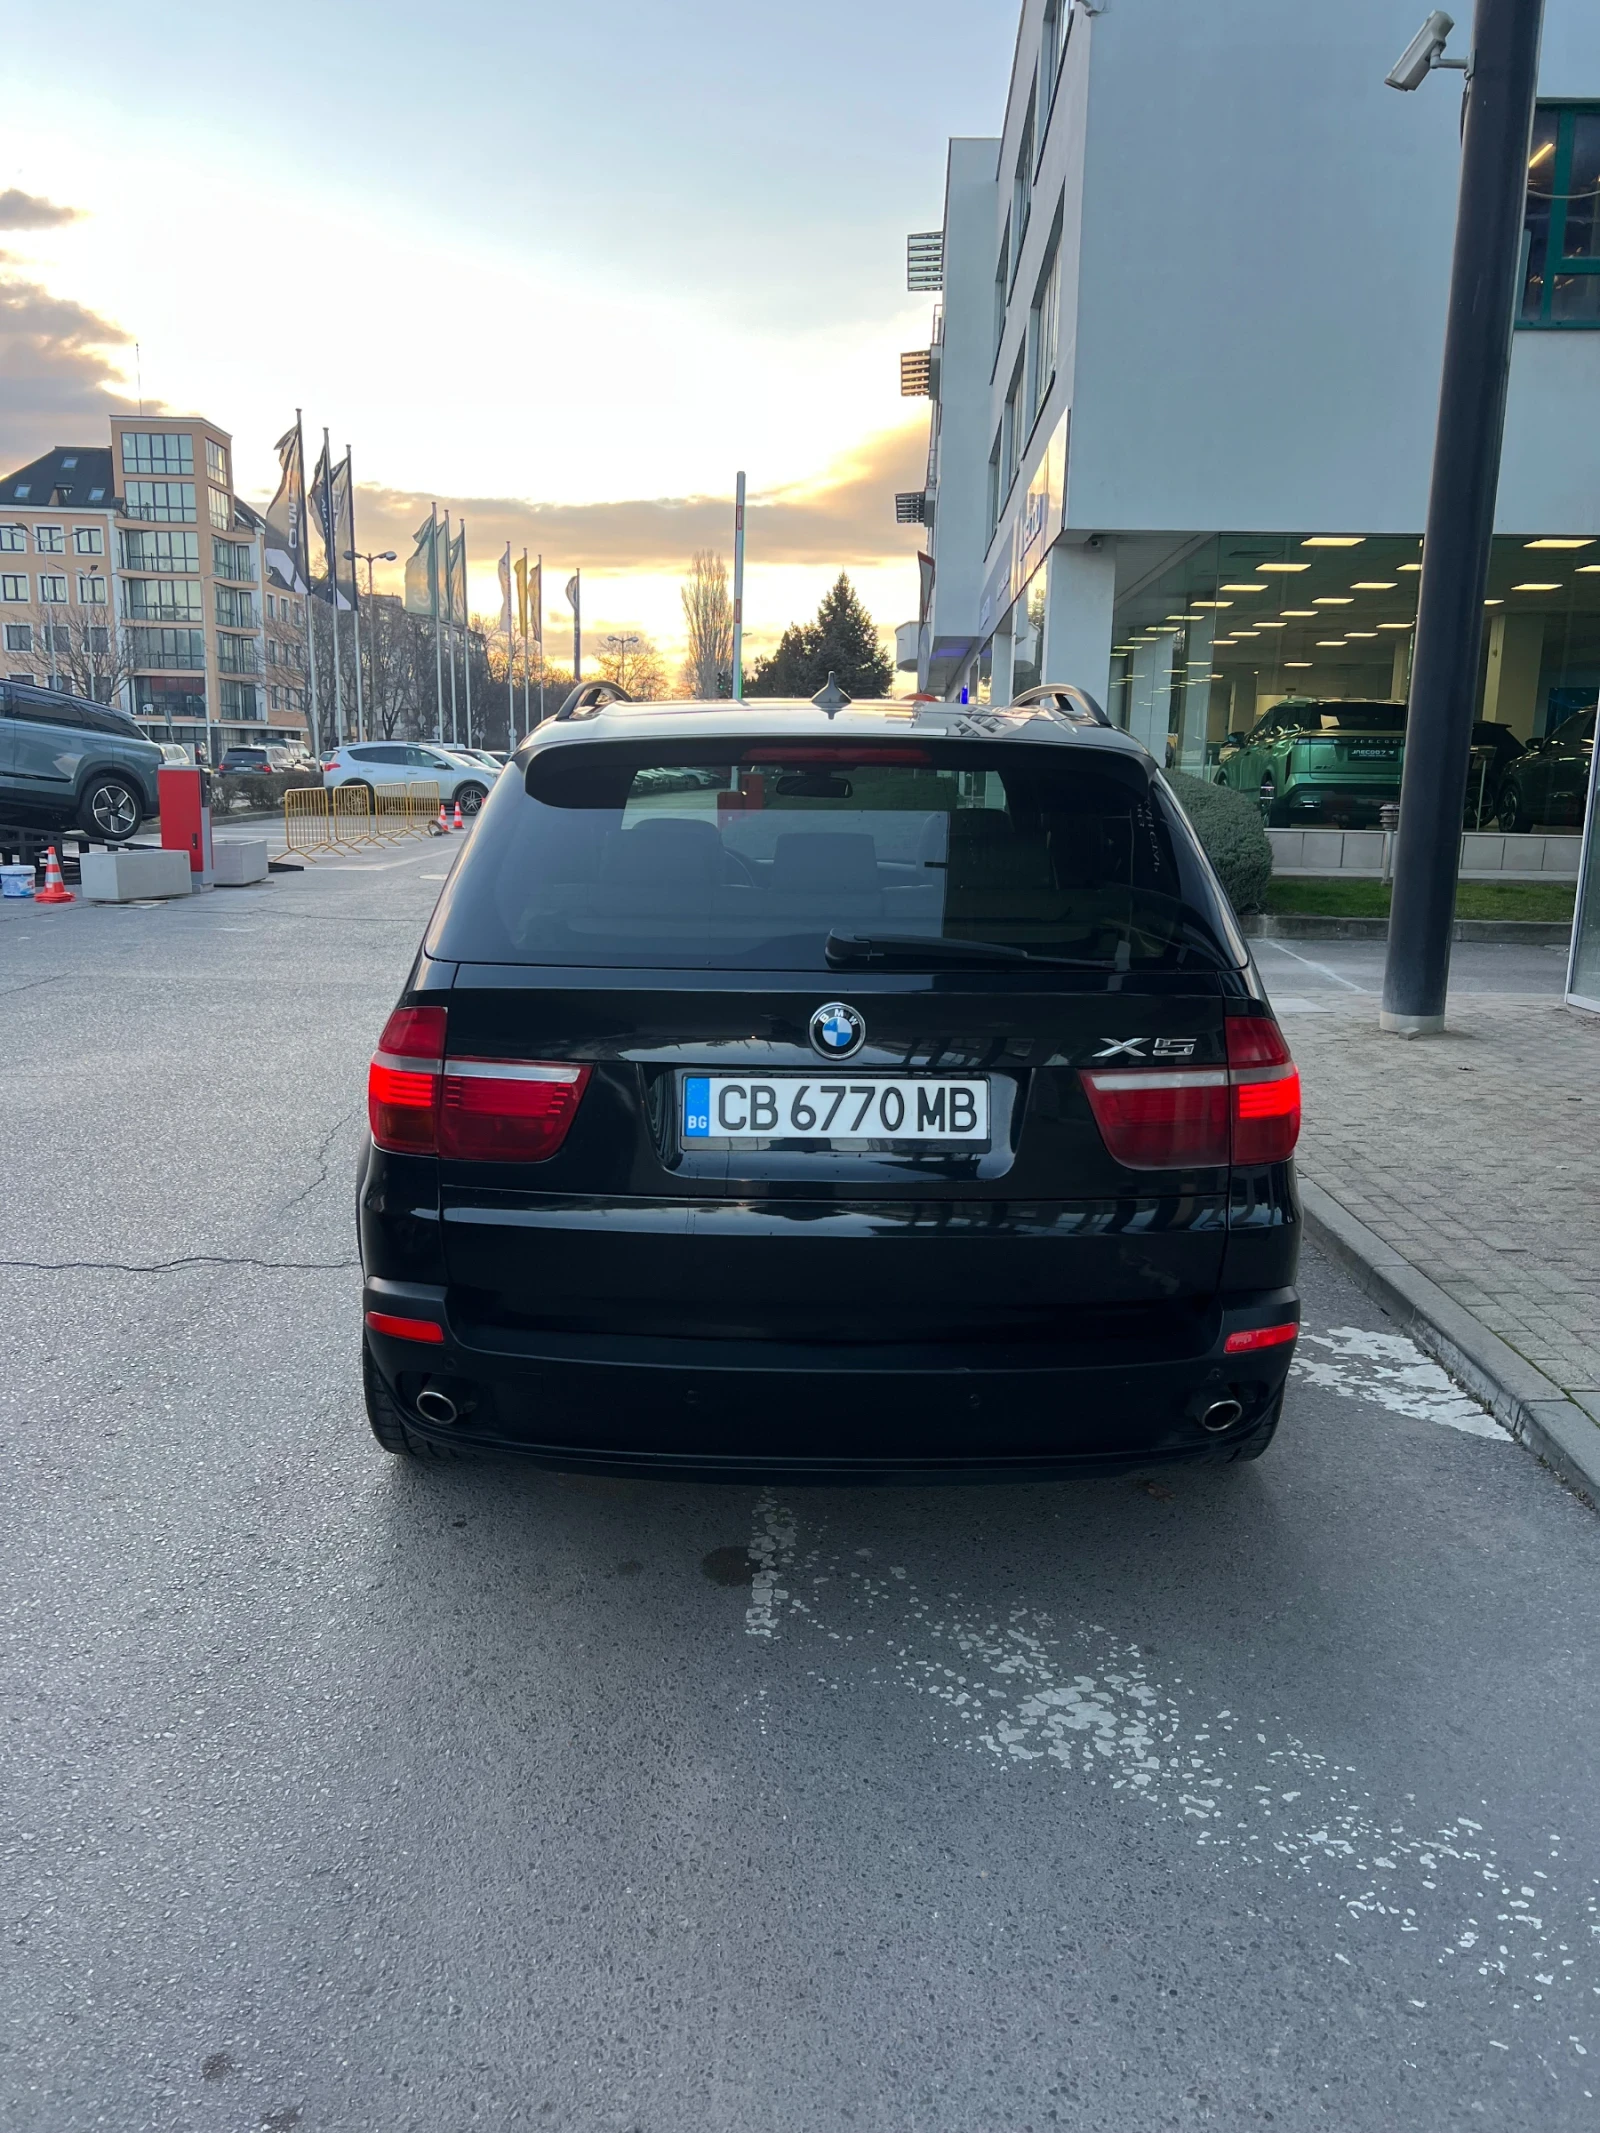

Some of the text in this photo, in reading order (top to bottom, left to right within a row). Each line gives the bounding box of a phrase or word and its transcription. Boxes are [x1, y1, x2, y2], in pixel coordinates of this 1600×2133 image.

[819, 1008, 859, 1026] BMW
[1091, 1037, 1197, 1056] X5
[718, 1084, 978, 1133] CB 6770 MB
[687, 1115, 707, 1129] BG
